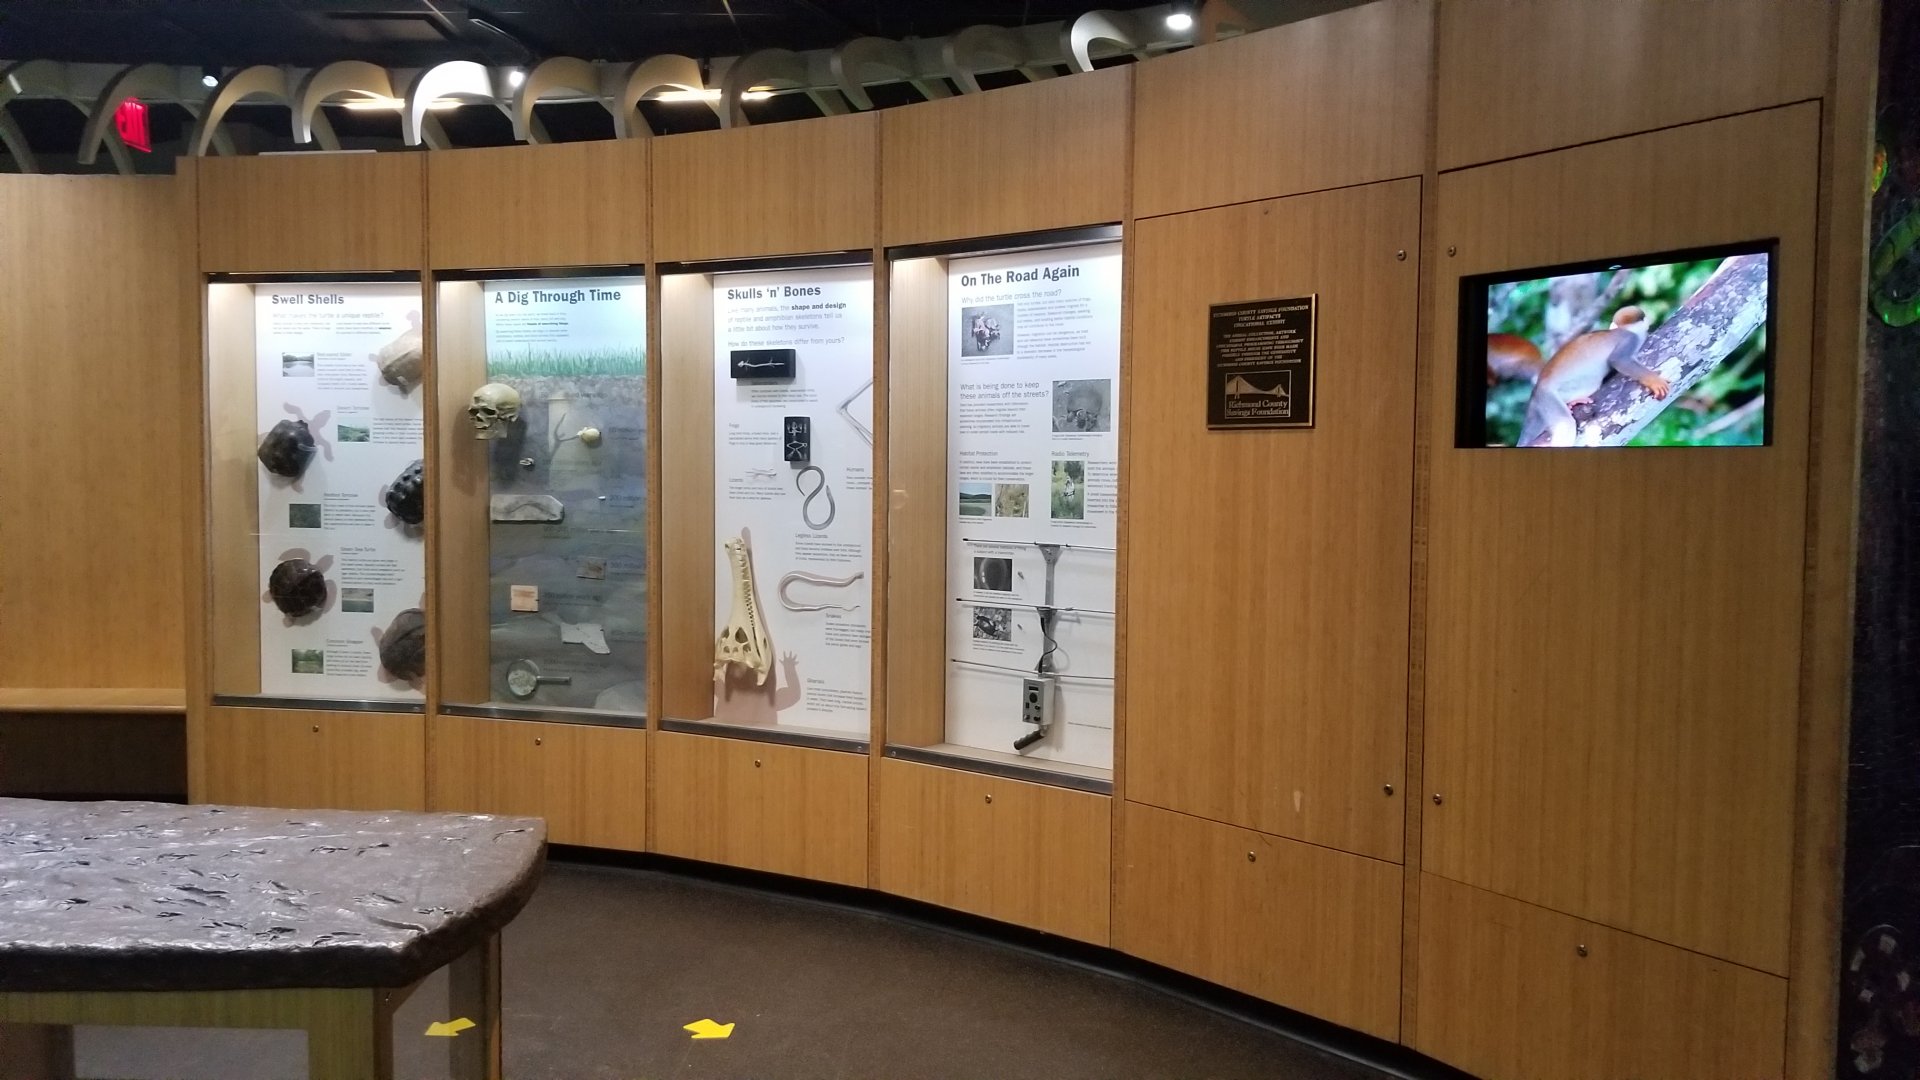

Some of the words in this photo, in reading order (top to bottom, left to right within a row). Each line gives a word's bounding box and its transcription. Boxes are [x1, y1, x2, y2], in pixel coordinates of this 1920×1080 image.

[961, 275, 977, 287] On
[980, 273, 1002, 286] The
[1006, 268, 1038, 283] Road
[1042, 265, 1080, 282] Again
[495, 292, 503, 304] A
[508, 291, 529, 306] Dig
[533, 290, 585, 304] Through
[590, 289, 621, 301] Time
[728, 288, 762, 300] Skulls
[784, 286, 821, 297] Bones
[962, 297, 974, 305] Why
[996, 293, 1012, 301] turtle
[1044, 289, 1062, 297] road?
[272, 294, 303, 304] Swell
[308, 294, 344, 304] Shells
[960, 383, 975, 391] What
[983, 382, 999, 391] being
[1025, 381, 1040, 390] keep
[960, 392, 976, 400] these
[978, 391, 1000, 399] animals
[1002, 390, 1011, 399] off
[1012, 390, 1022, 398] the
[1023, 390, 1050, 398] streets?
[1262, 400, 1288, 408] County
[1252, 408, 1289, 416] Foundation
